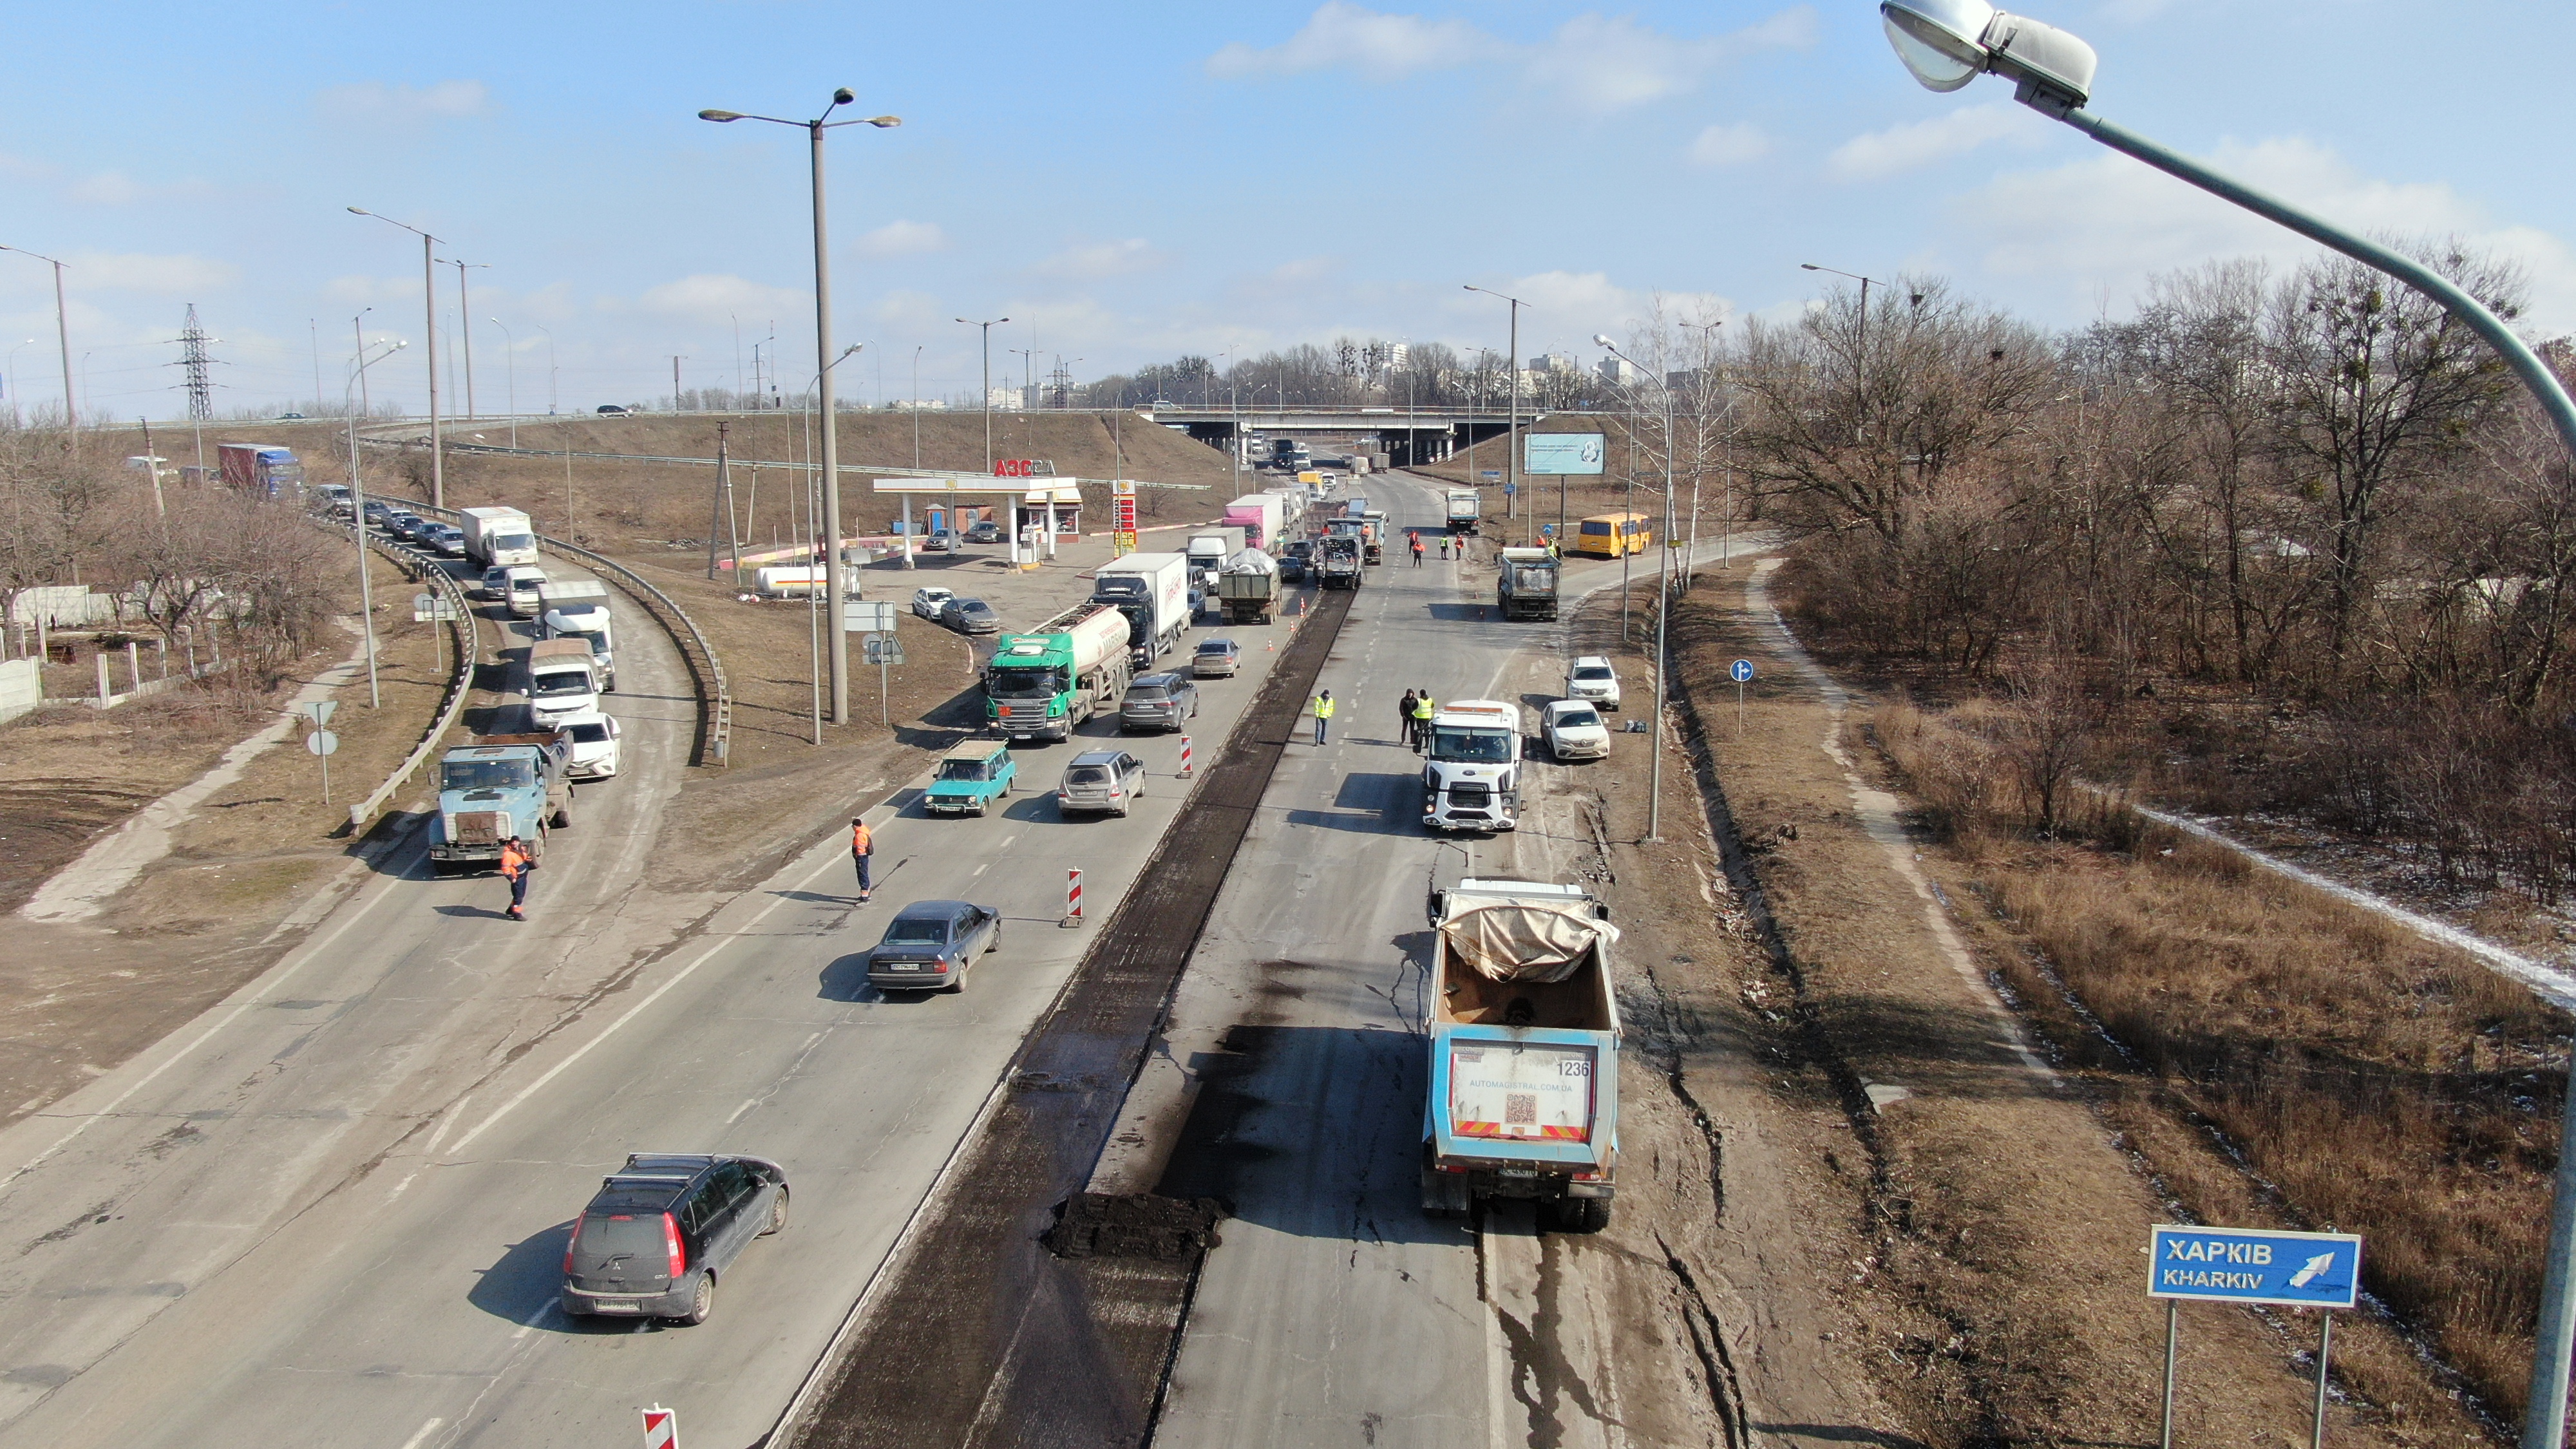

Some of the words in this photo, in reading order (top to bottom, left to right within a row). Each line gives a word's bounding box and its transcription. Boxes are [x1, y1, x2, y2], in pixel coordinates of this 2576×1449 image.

[994, 459, 1032, 477] АЗС
[1557, 1062, 1589, 1077] 1236
[1470, 1079, 1573, 1092] AUTOMAGISTRAL.COM.UA
[2166, 1239, 2273, 1265] ХАРКІВ
[2163, 1269, 2264, 1289] KHARKIV
